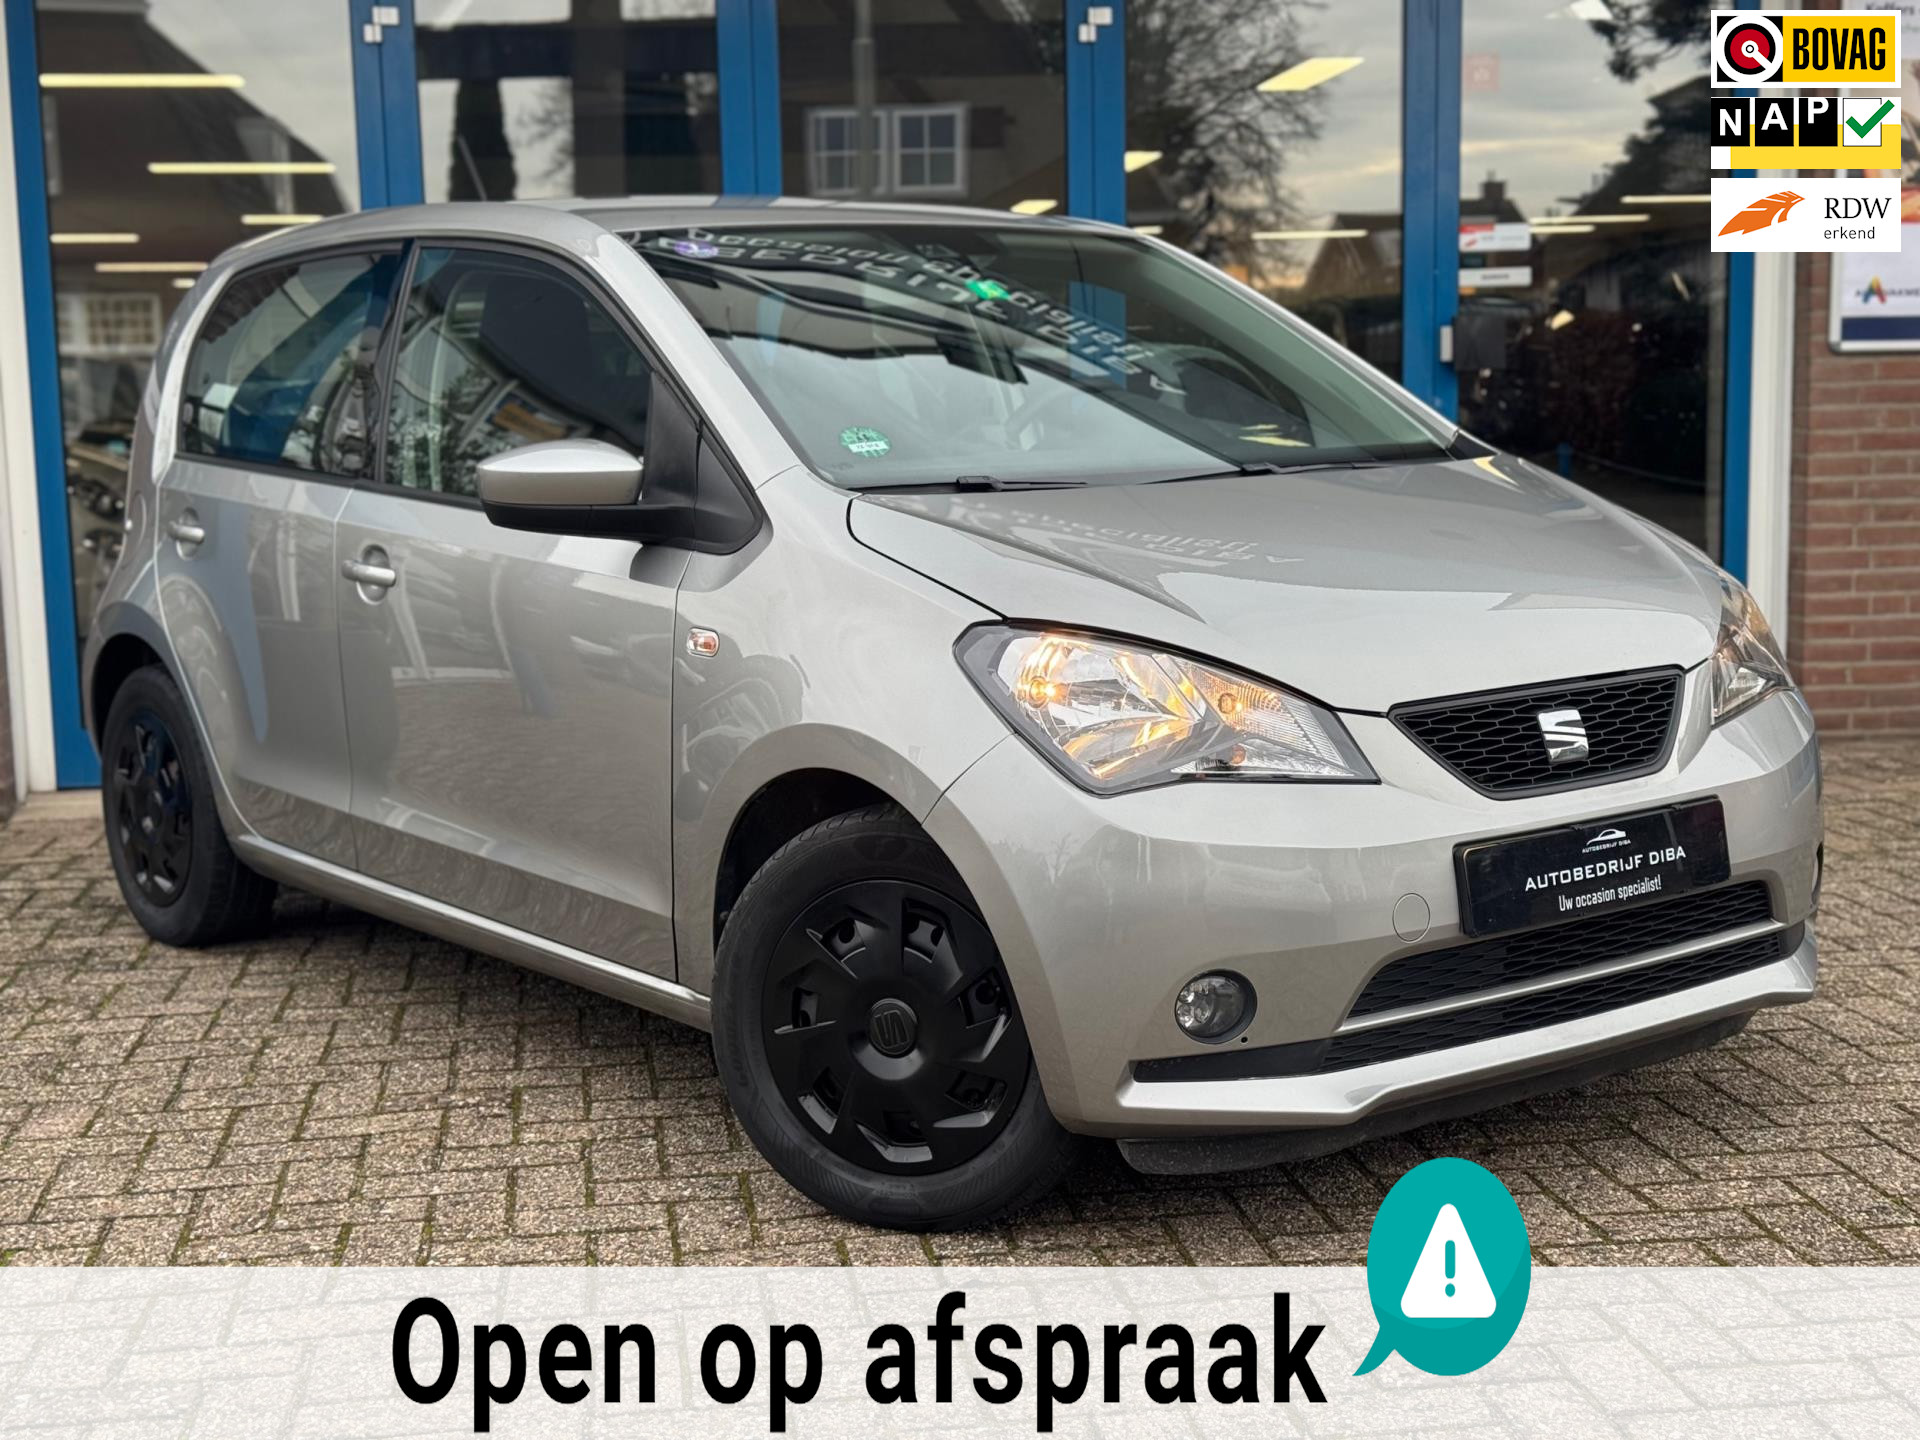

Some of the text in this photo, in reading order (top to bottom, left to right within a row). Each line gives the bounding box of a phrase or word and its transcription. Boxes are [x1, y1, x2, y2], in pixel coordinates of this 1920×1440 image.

[1524, 845, 1687, 892] AUTOBEDRIJF DIBA
[1558, 873, 1663, 912] Uw occasion specialist!
